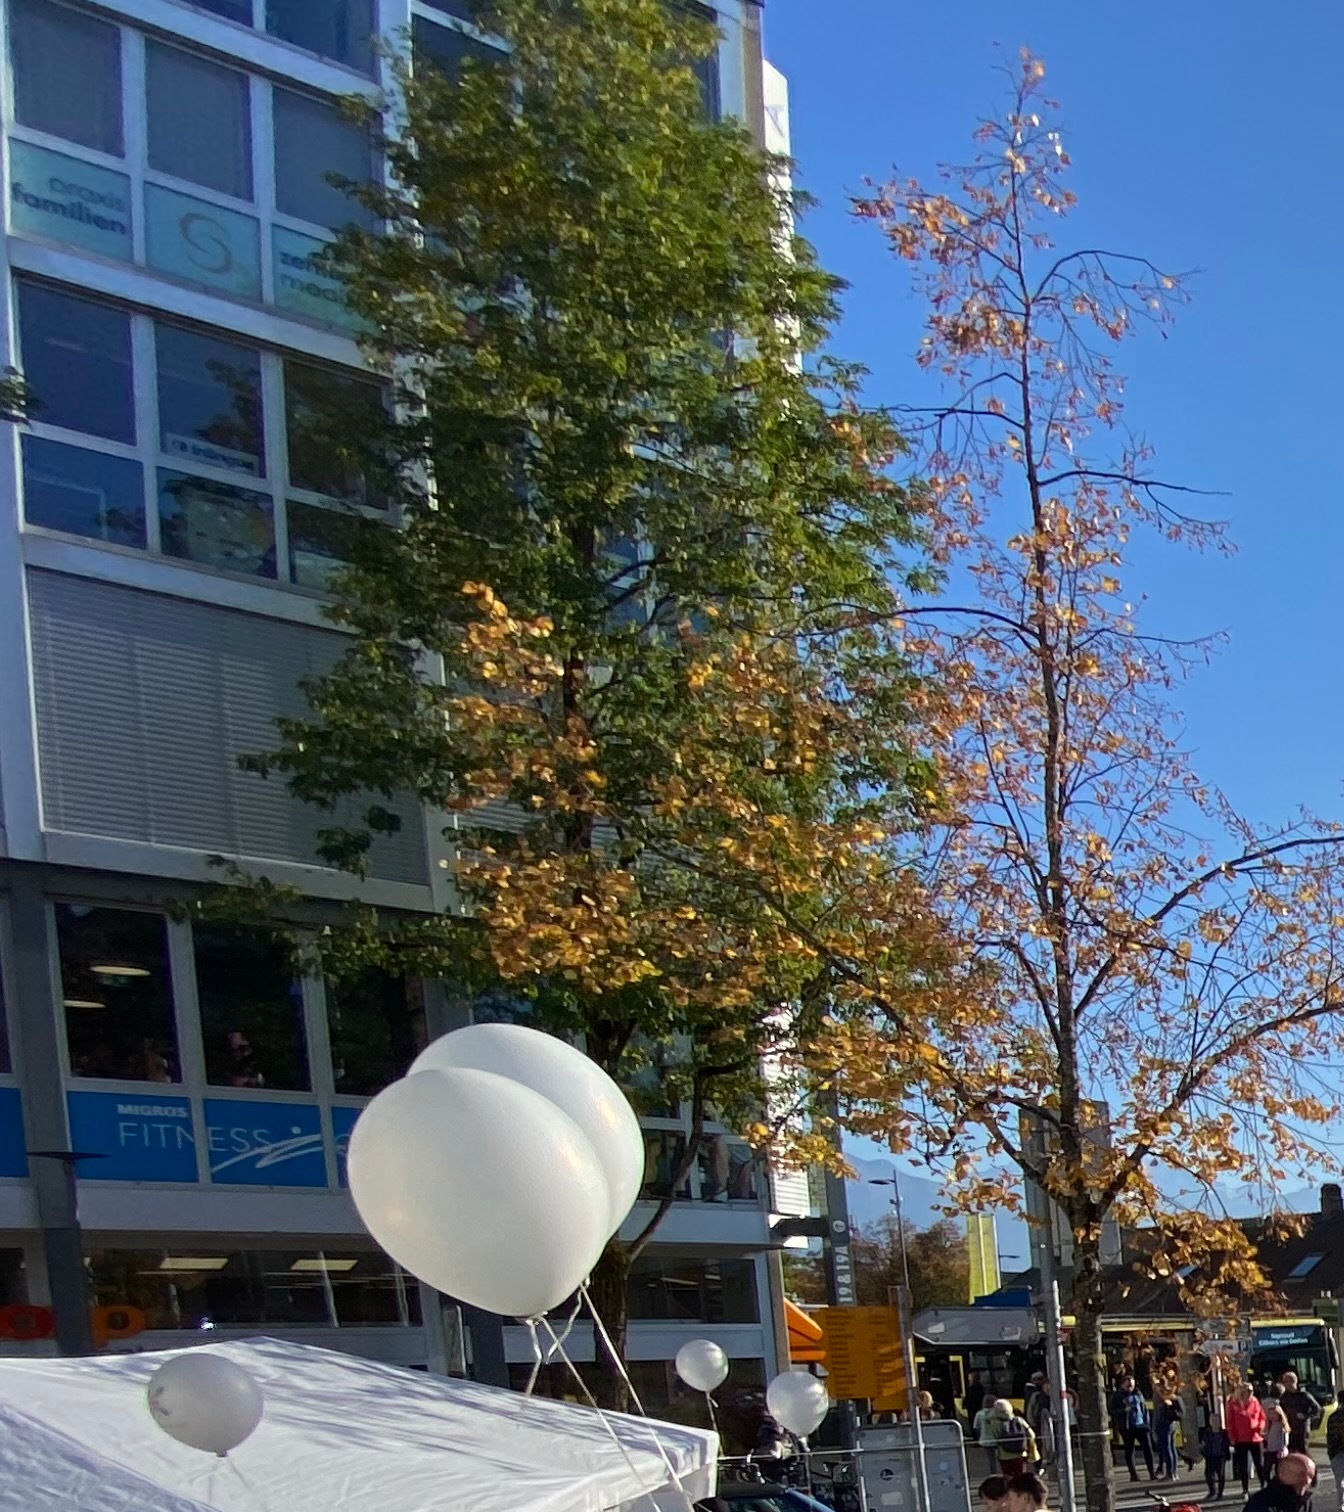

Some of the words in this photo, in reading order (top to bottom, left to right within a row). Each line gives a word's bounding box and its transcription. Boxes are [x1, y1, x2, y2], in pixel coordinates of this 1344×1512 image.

[12, 182, 126, 235] familien
[48, 177, 125, 212] praxis
[117, 1103, 188, 1117] MIGROS
[118, 1121, 273, 1153] FITNESS
